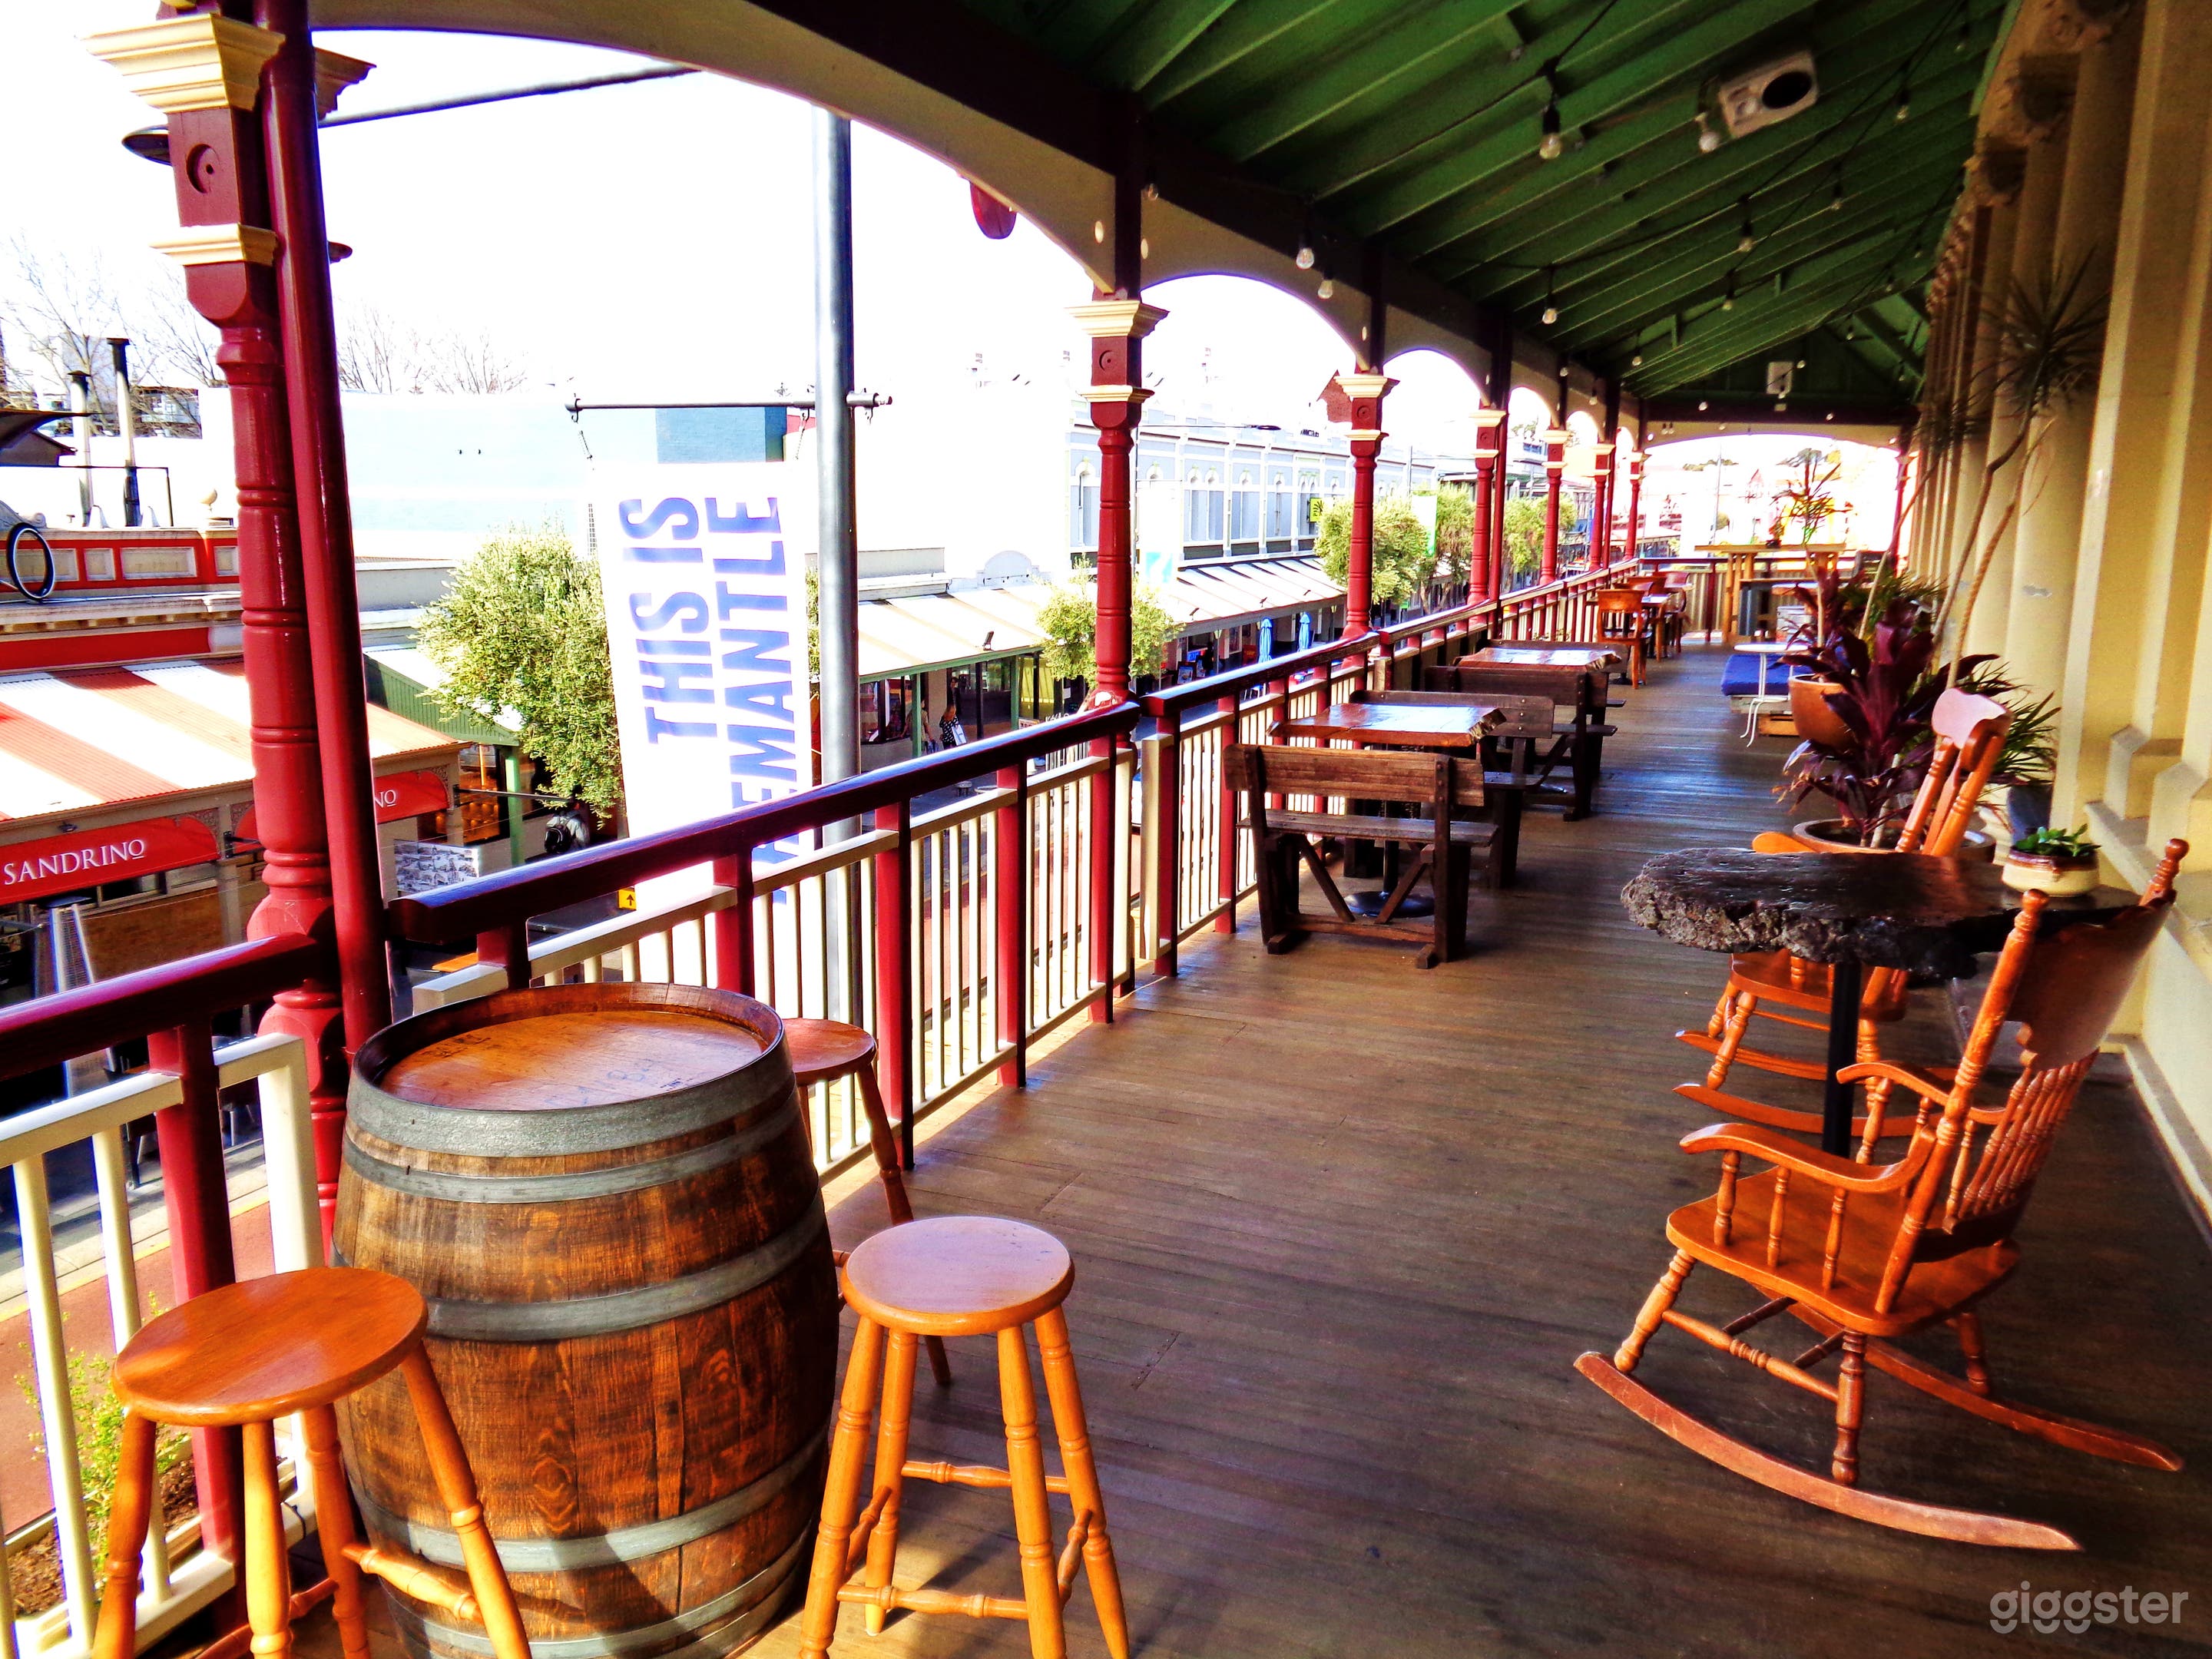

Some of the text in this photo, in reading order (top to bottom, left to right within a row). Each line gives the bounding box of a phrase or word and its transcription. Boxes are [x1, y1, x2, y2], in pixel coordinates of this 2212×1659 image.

[618, 497, 717, 744] THIS IS
[3, 839, 145, 886] SANDRINO
